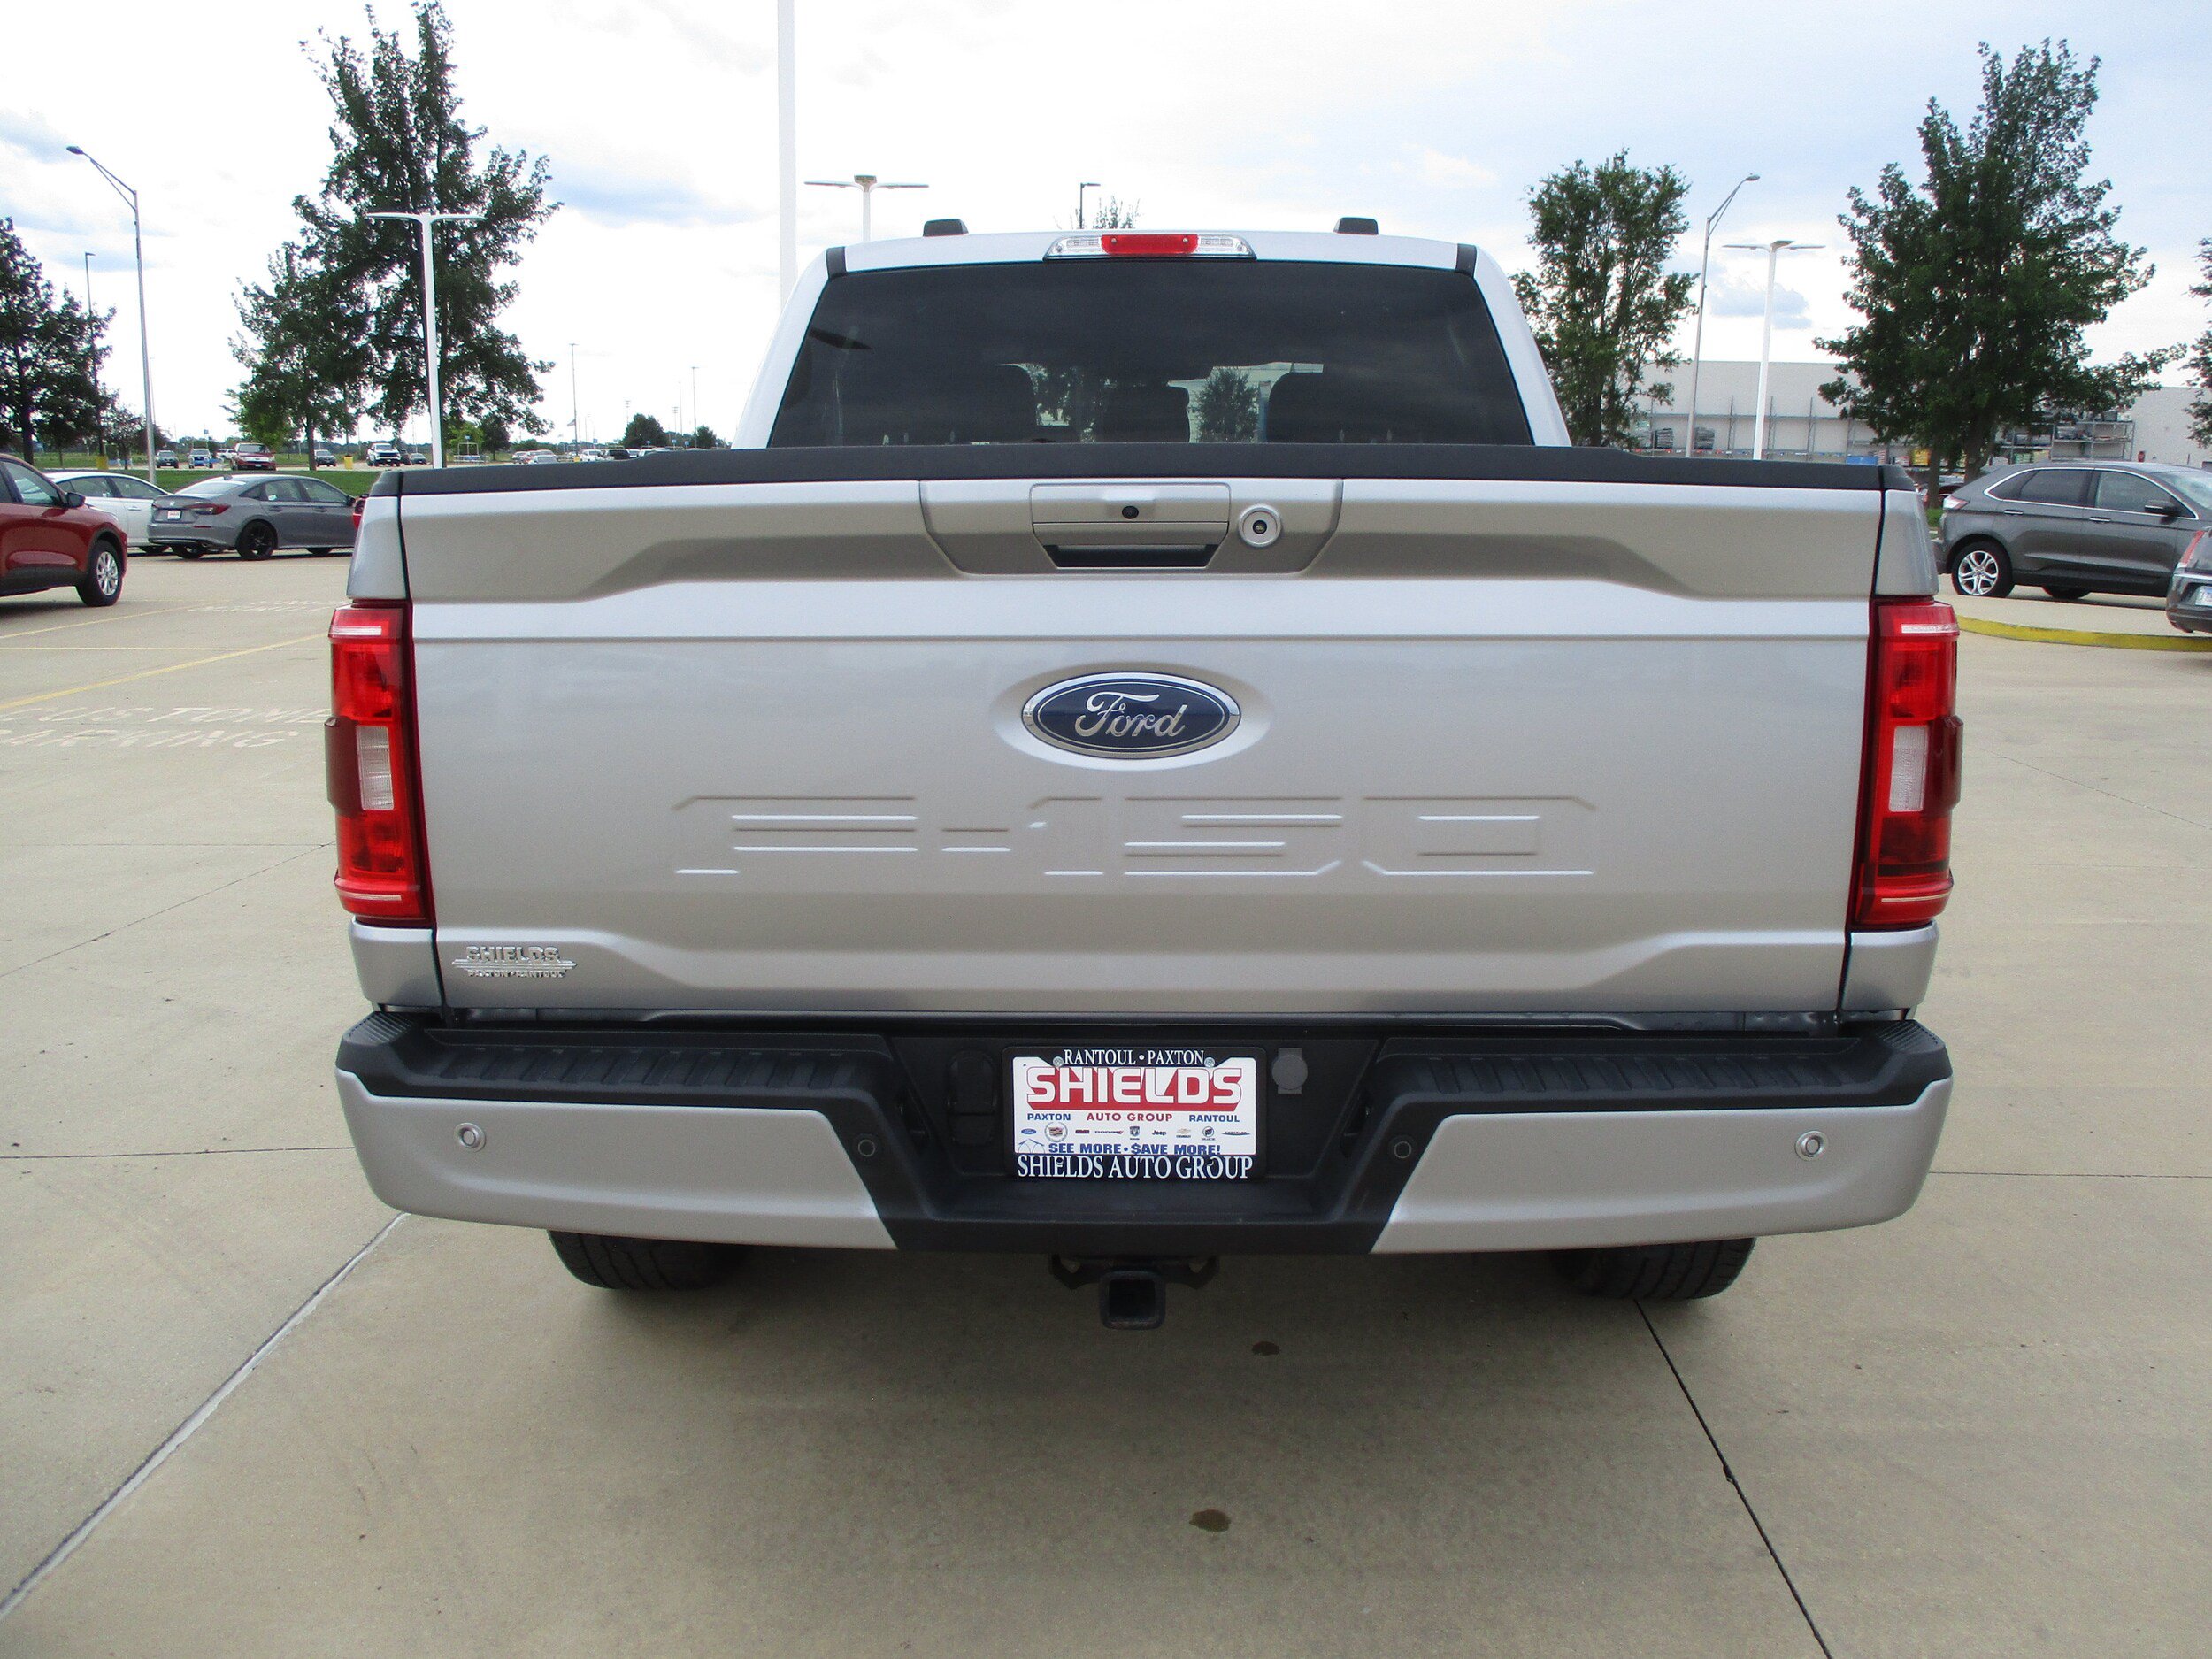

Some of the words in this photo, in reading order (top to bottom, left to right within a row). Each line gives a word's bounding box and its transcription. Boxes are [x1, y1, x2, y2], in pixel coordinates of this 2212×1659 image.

[1074, 691, 1188, 737] Ford
[466, 946, 561, 963] SHIELDS
[1064, 1049, 1136, 1065] RANTOUL
[1148, 1050, 1204, 1065] PAXTON
[1026, 1066, 1242, 1111] SHIELDS
[1127, 1113, 1172, 1122] GROUP
[1048, 1143, 1074, 1153] SEE
[1080, 1144, 1121, 1154] MORE
[1131, 1143, 1168, 1155] $AVE
[1174, 1145, 1220, 1155] MORE!
[1018, 1156, 1104, 1177] SHIELDS
[1109, 1156, 1171, 1179] AUTO
[1176, 1156, 1253, 1179] GROUP
